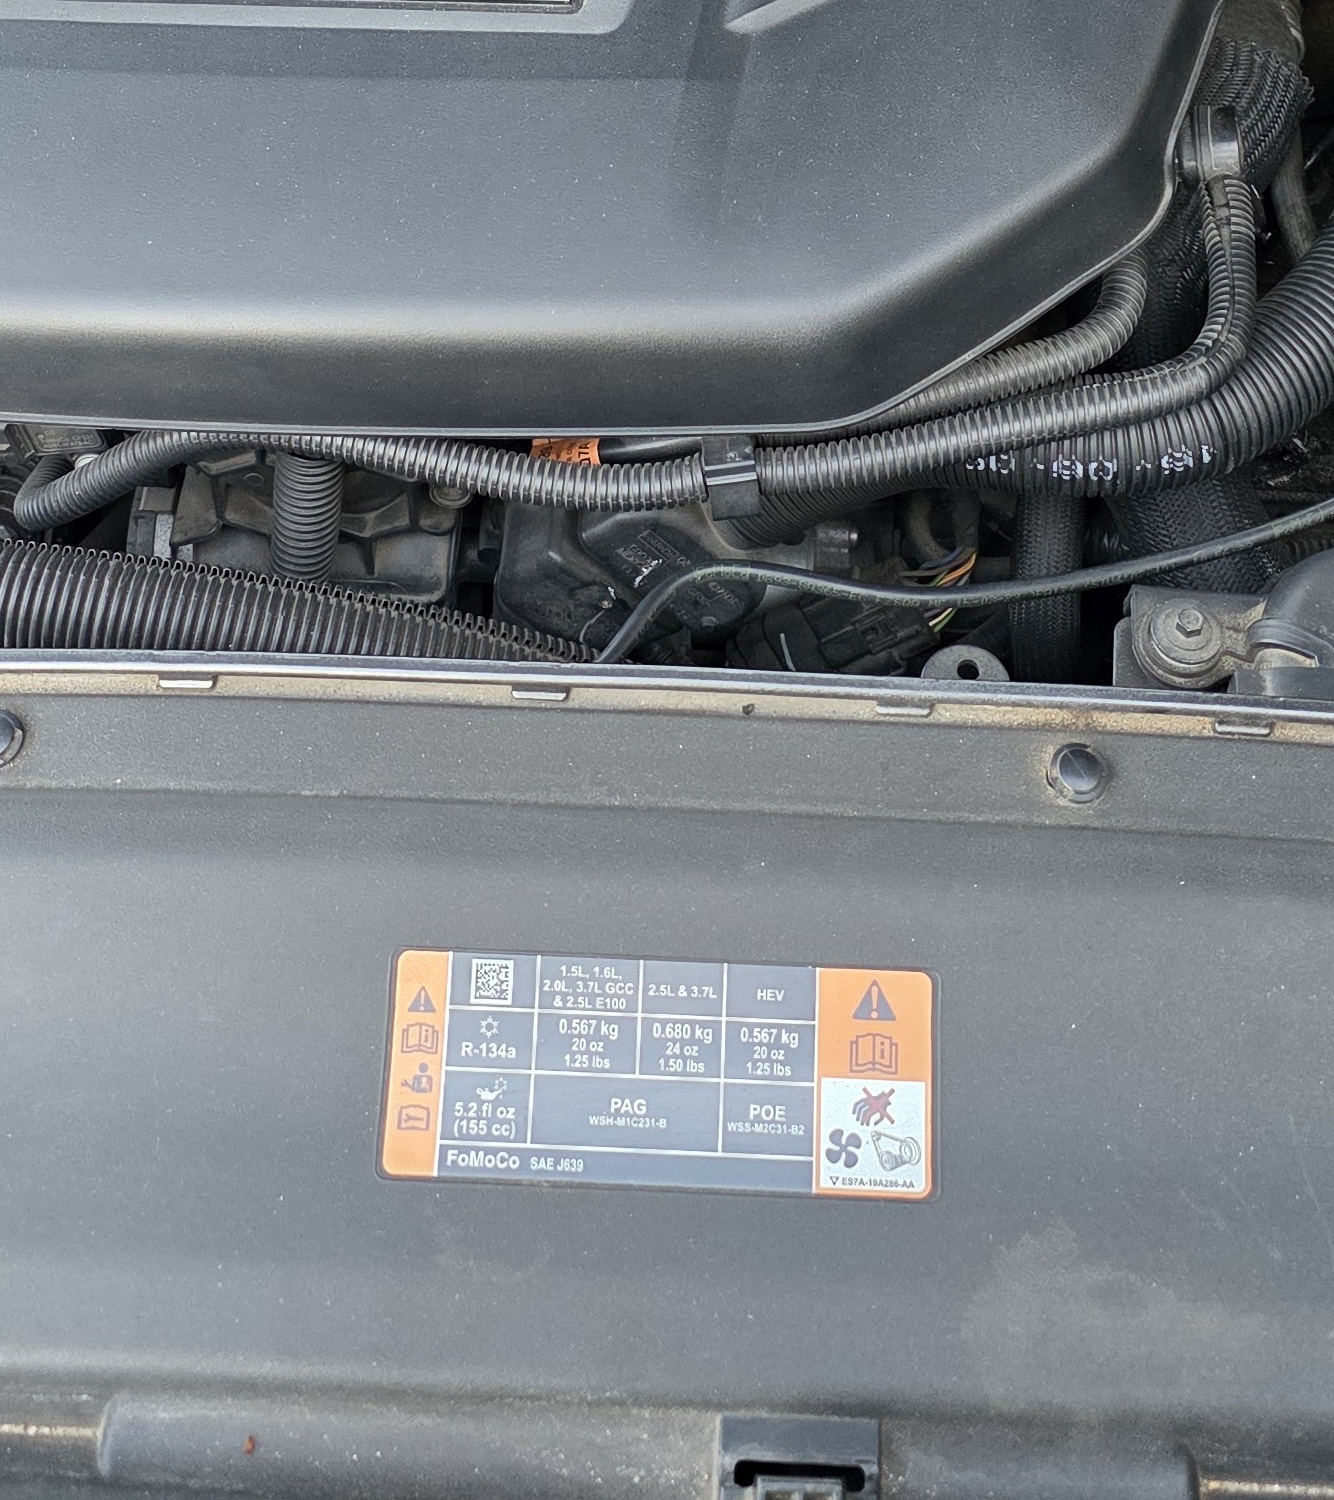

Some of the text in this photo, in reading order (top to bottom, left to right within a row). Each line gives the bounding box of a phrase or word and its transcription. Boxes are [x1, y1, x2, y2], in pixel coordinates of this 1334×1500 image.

[560, 965, 623, 980] 1.5L, 1.6L,
[543, 980, 634, 995] 2.0L, 3.7L GCC
[647, 984, 718, 999] 2.5L & 3.7L
[756, 988, 785, 1002] HEV
[553, 997, 627, 1010] & 2.5L E100
[559, 1019, 619, 1040] 0.567 kg
[652, 1022, 713, 1044] 0.680 kg
[740, 1026, 799, 1048] 0.567 kg
[461, 1042, 516, 1059] R-134a
[572, 1038, 604, 1052] 20 oz
[666, 1041, 699, 1056] 24 oz
[753, 1046, 785, 1060] 20 oz
[564, 1054, 611, 1069] 1.25 lbs
[658, 1058, 705, 1073] 1.50 lbs
[746, 1062, 792, 1076] 1.25 lbs
[454, 1102, 516, 1119] 5.2 fl oz
[610, 1098, 647, 1115] PAG
[749, 1104, 786, 1121] POE
[453, 1119, 516, 1139] (155 cc)
[589, 1115, 667, 1129] WSH-M1C231-B
[446, 1149, 520, 1170] FoMoCo
[530, 1156, 584, 1173] SAE J639
